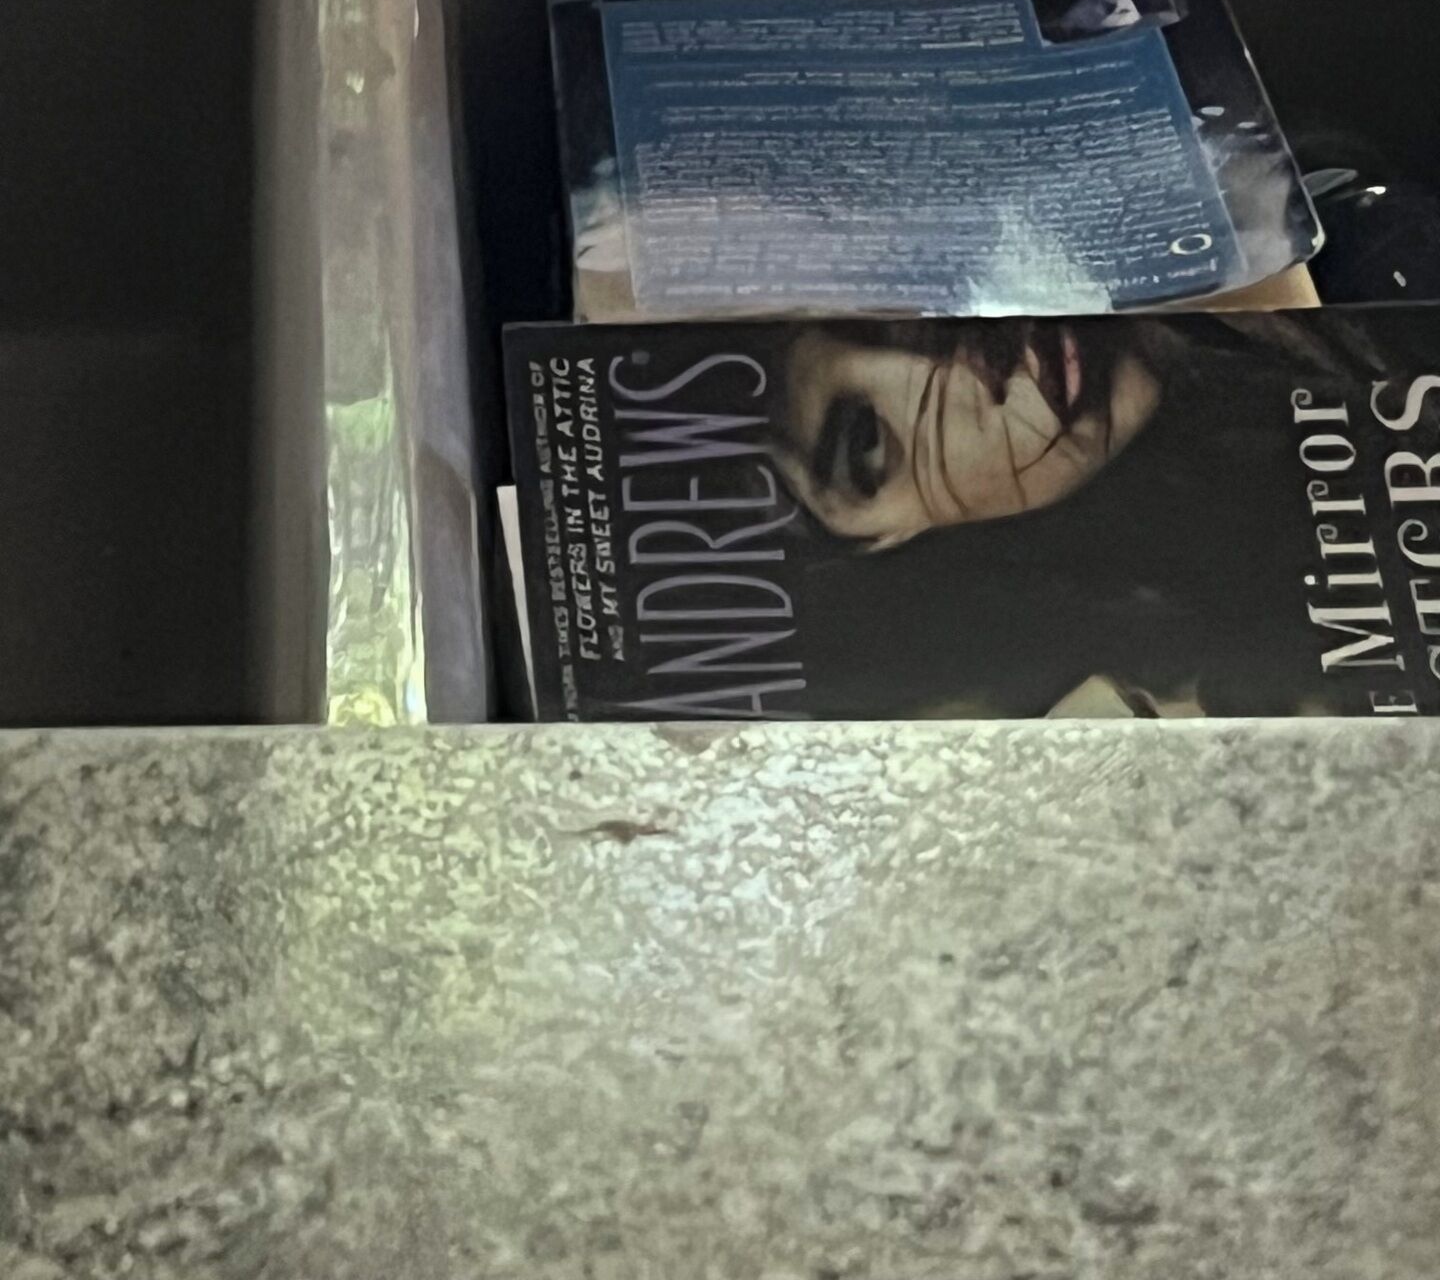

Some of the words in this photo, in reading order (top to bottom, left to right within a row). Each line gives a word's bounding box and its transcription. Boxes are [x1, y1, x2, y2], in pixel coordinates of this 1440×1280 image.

[549, 357, 575, 438] ATTIC
[576, 357, 605, 482] AUDRINA
[557, 445, 581, 498] THE
[563, 506, 586, 533] IN
[588, 489, 615, 575] SWEET
[608, 353, 807, 719] ANDREWS
[1291, 388, 1405, 672] Mirror
[567, 543, 602, 661] FLOWERS
[598, 580, 621, 618] MY
